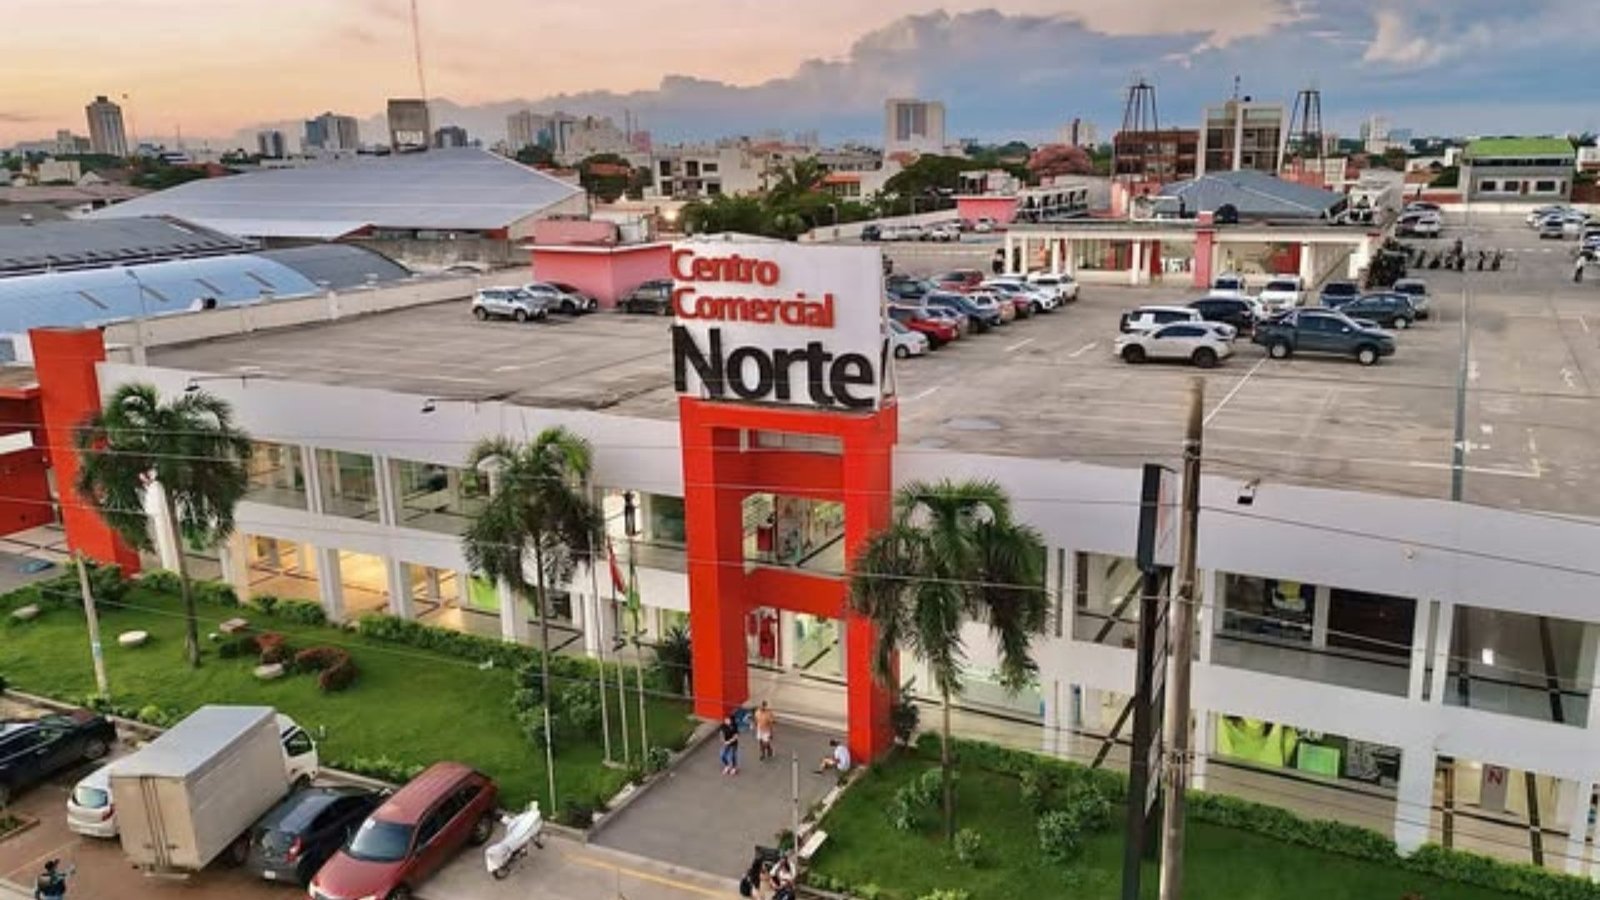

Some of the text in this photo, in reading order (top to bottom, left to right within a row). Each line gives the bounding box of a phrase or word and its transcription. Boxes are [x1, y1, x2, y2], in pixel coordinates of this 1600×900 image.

[670, 249, 780, 286] Centro
[671, 288, 834, 328] Comercial
[672, 325, 875, 408] Norte
